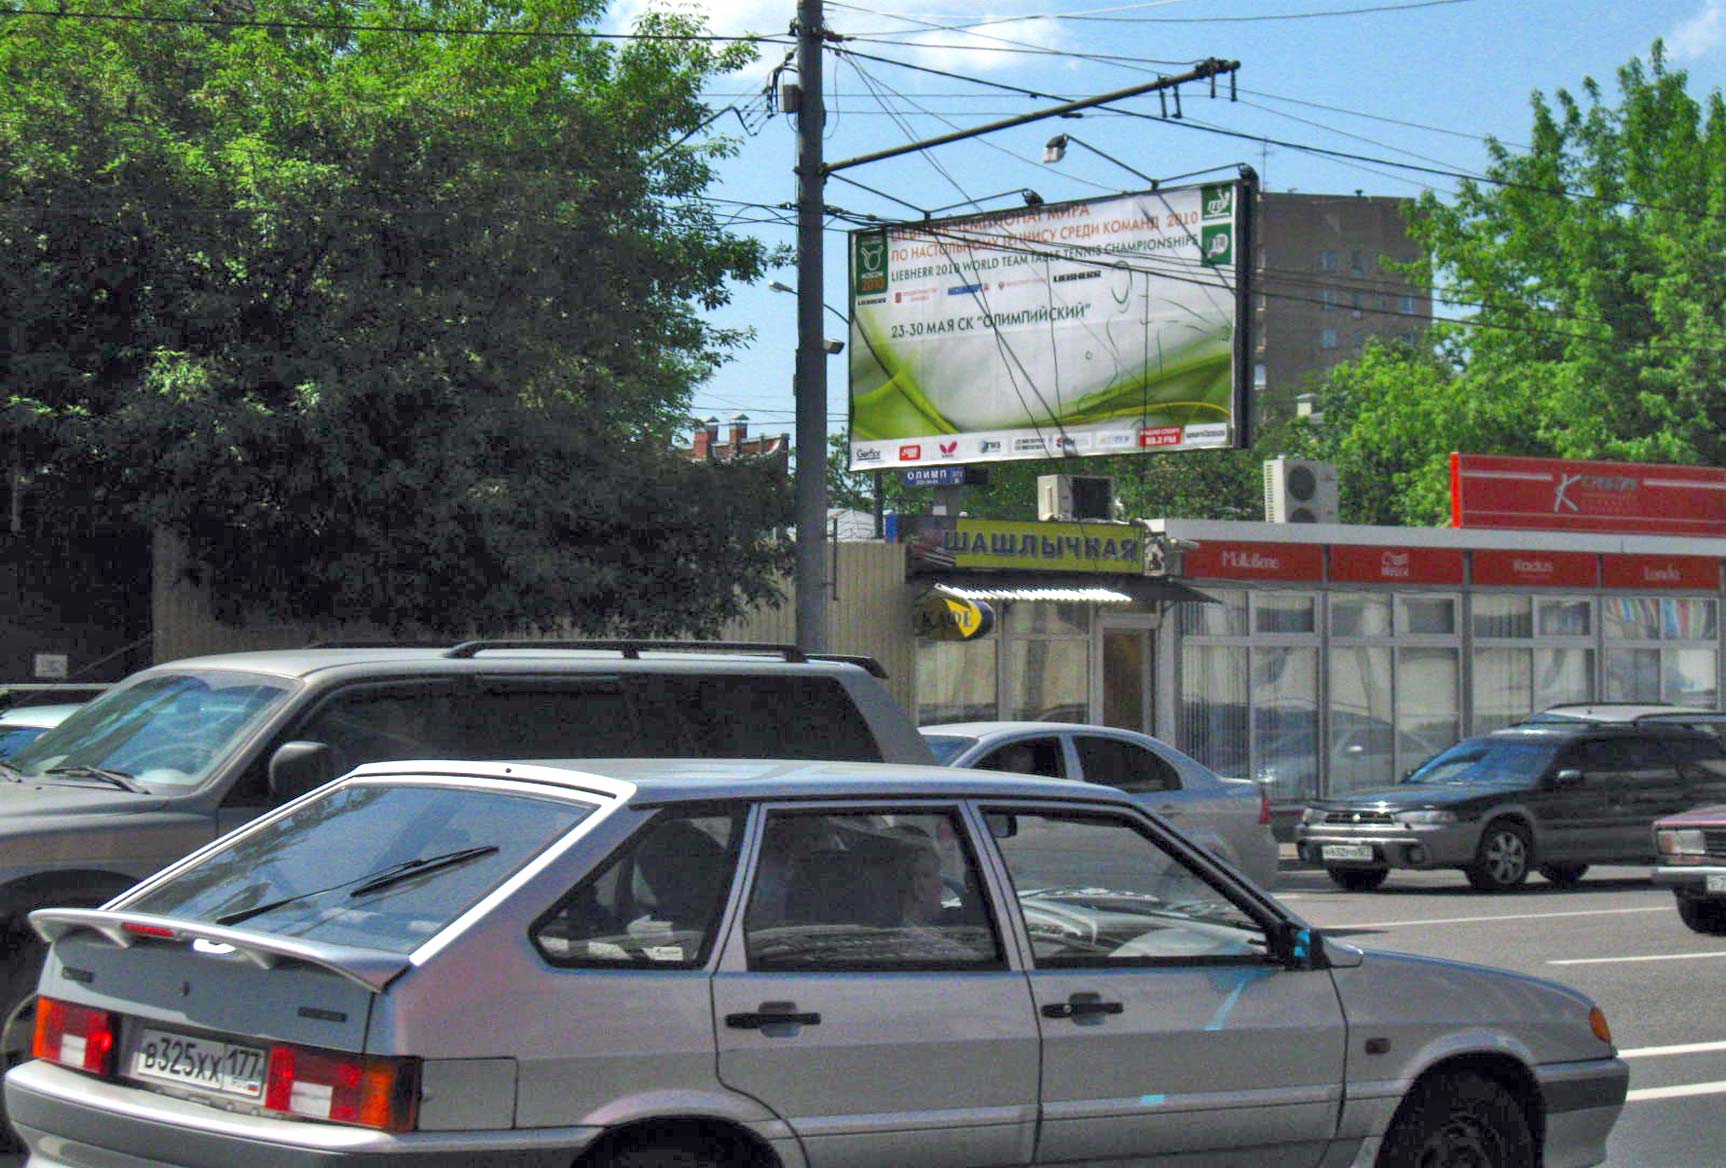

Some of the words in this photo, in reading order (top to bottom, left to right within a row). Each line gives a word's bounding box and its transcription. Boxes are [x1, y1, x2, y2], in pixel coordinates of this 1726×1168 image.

[1048, 203, 1089, 221] МИРА
[892, 249, 908, 262] ПО
[1003, 228, 1056, 249] ТЕННИСУ
[1060, 223, 1099, 240] СРЕДИ
[1103, 217, 1159, 234] КОМАНД
[1167, 211, 1199, 228] 2010
[891, 267, 933, 282] LIEBHERR
[936, 262, 961, 276] 2010
[963, 257, 999, 273] WORLD
[1002, 253, 1028, 267] TEAM
[1063, 243, 1102, 259] TENNIS
[1104, 233, 1198, 254] CHAMPIONSHIPS
[892, 323, 923, 339] 23-30
[927, 319, 954, 334] МАЯ
[957, 316, 974, 331] СК
[907, 469, 947, 480] ОЛИМП
[943, 531, 1138, 561] ШАШЛЫЧНАЯ
